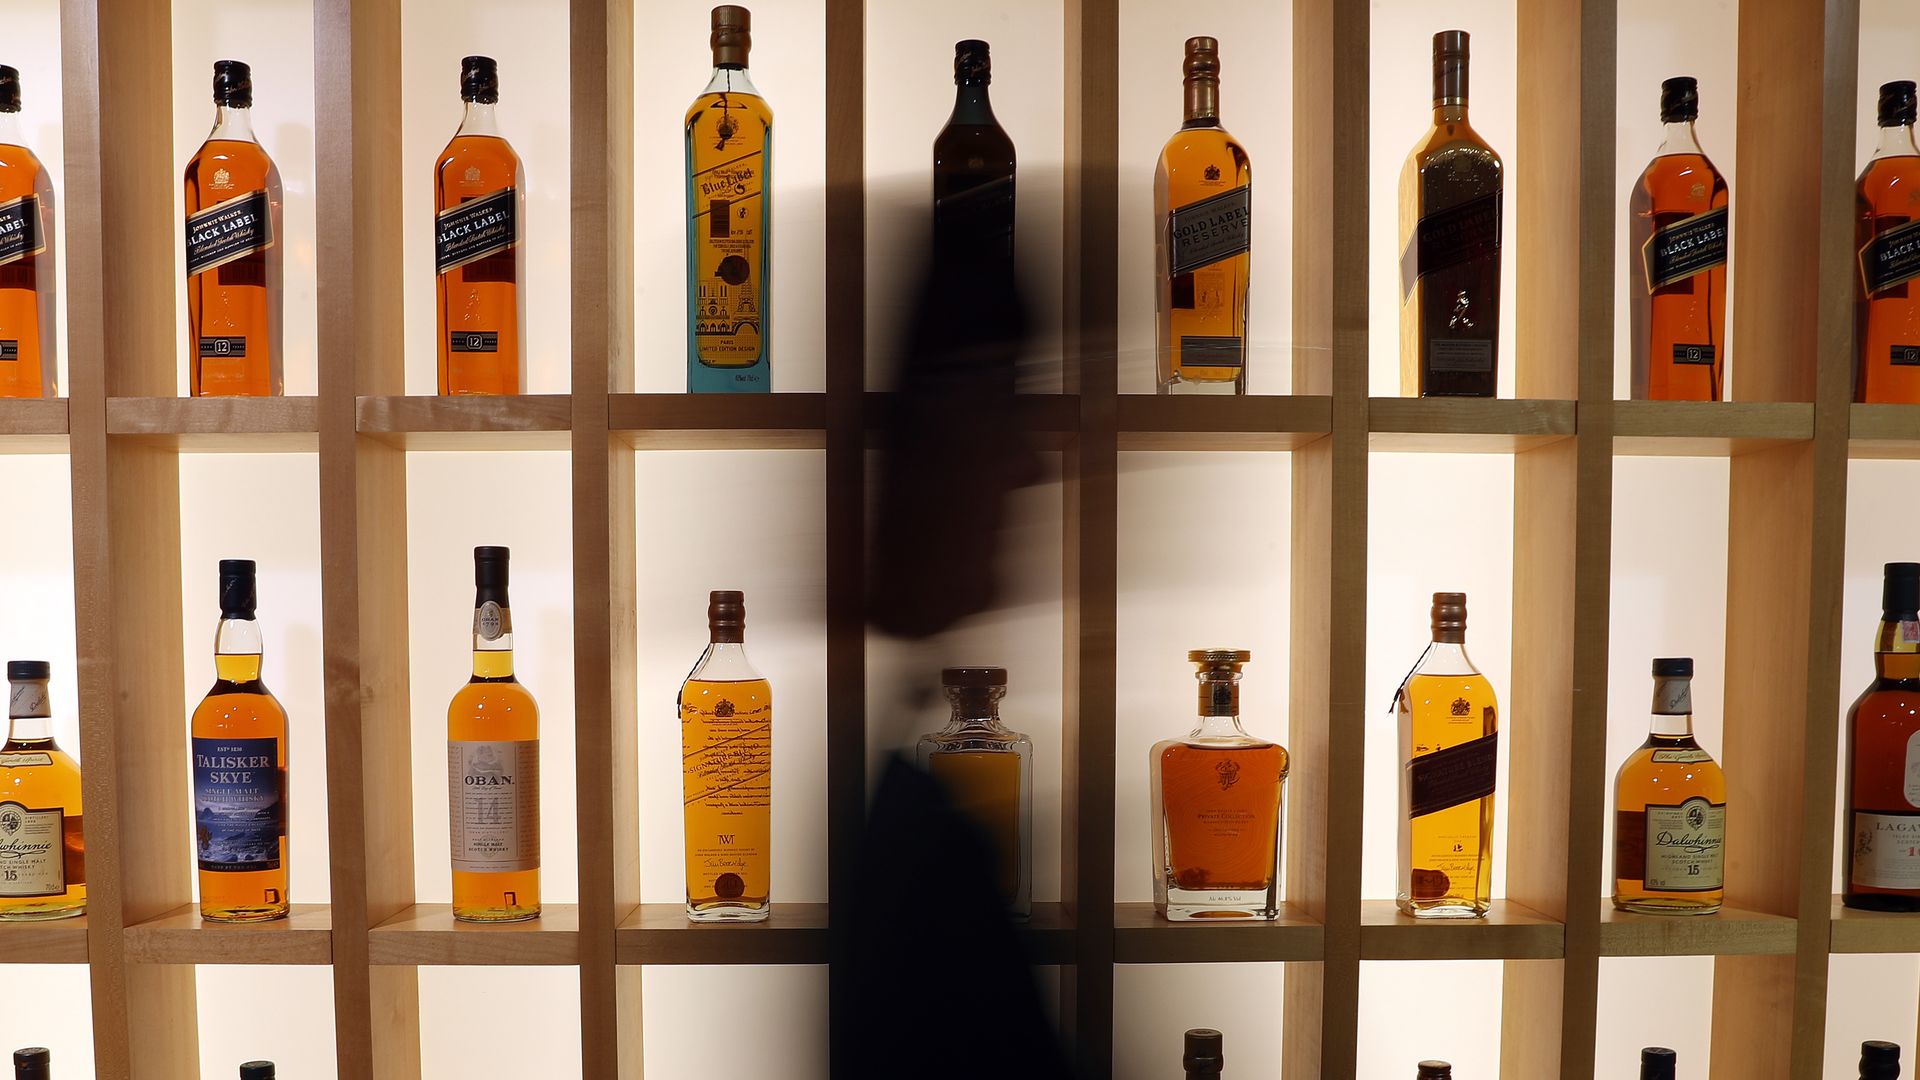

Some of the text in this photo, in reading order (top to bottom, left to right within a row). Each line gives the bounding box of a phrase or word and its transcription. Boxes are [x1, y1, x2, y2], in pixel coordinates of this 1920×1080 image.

[701, 181, 725, 195] Blue
[725, 168, 755, 186] Label
[0, 218, 28, 235] ABEL
[221, 213, 258, 233] LABEL
[473, 211, 510, 230] LABEL
[1173, 220, 1208, 240] GOLD
[1209, 206, 1249, 227] LABEL
[1183, 218, 1249, 247] RESERVE
[1660, 238, 1695, 257] BLACK
[1880, 242, 1915, 261] BLACK
[217, 342, 228, 352] 12
[469, 337, 480, 347] 12
[1689, 350, 1699, 359] 12
[1906, 351, 1917, 360] 12
[195, 754, 271, 769] TALISKER
[210, 771, 253, 784] SKYE
[1876, 822, 1920, 832] LAGA
[0, 838, 53, 851] whinnie
[4, 870, 18, 881] 15
[1687, 864, 1701, 876] 15
